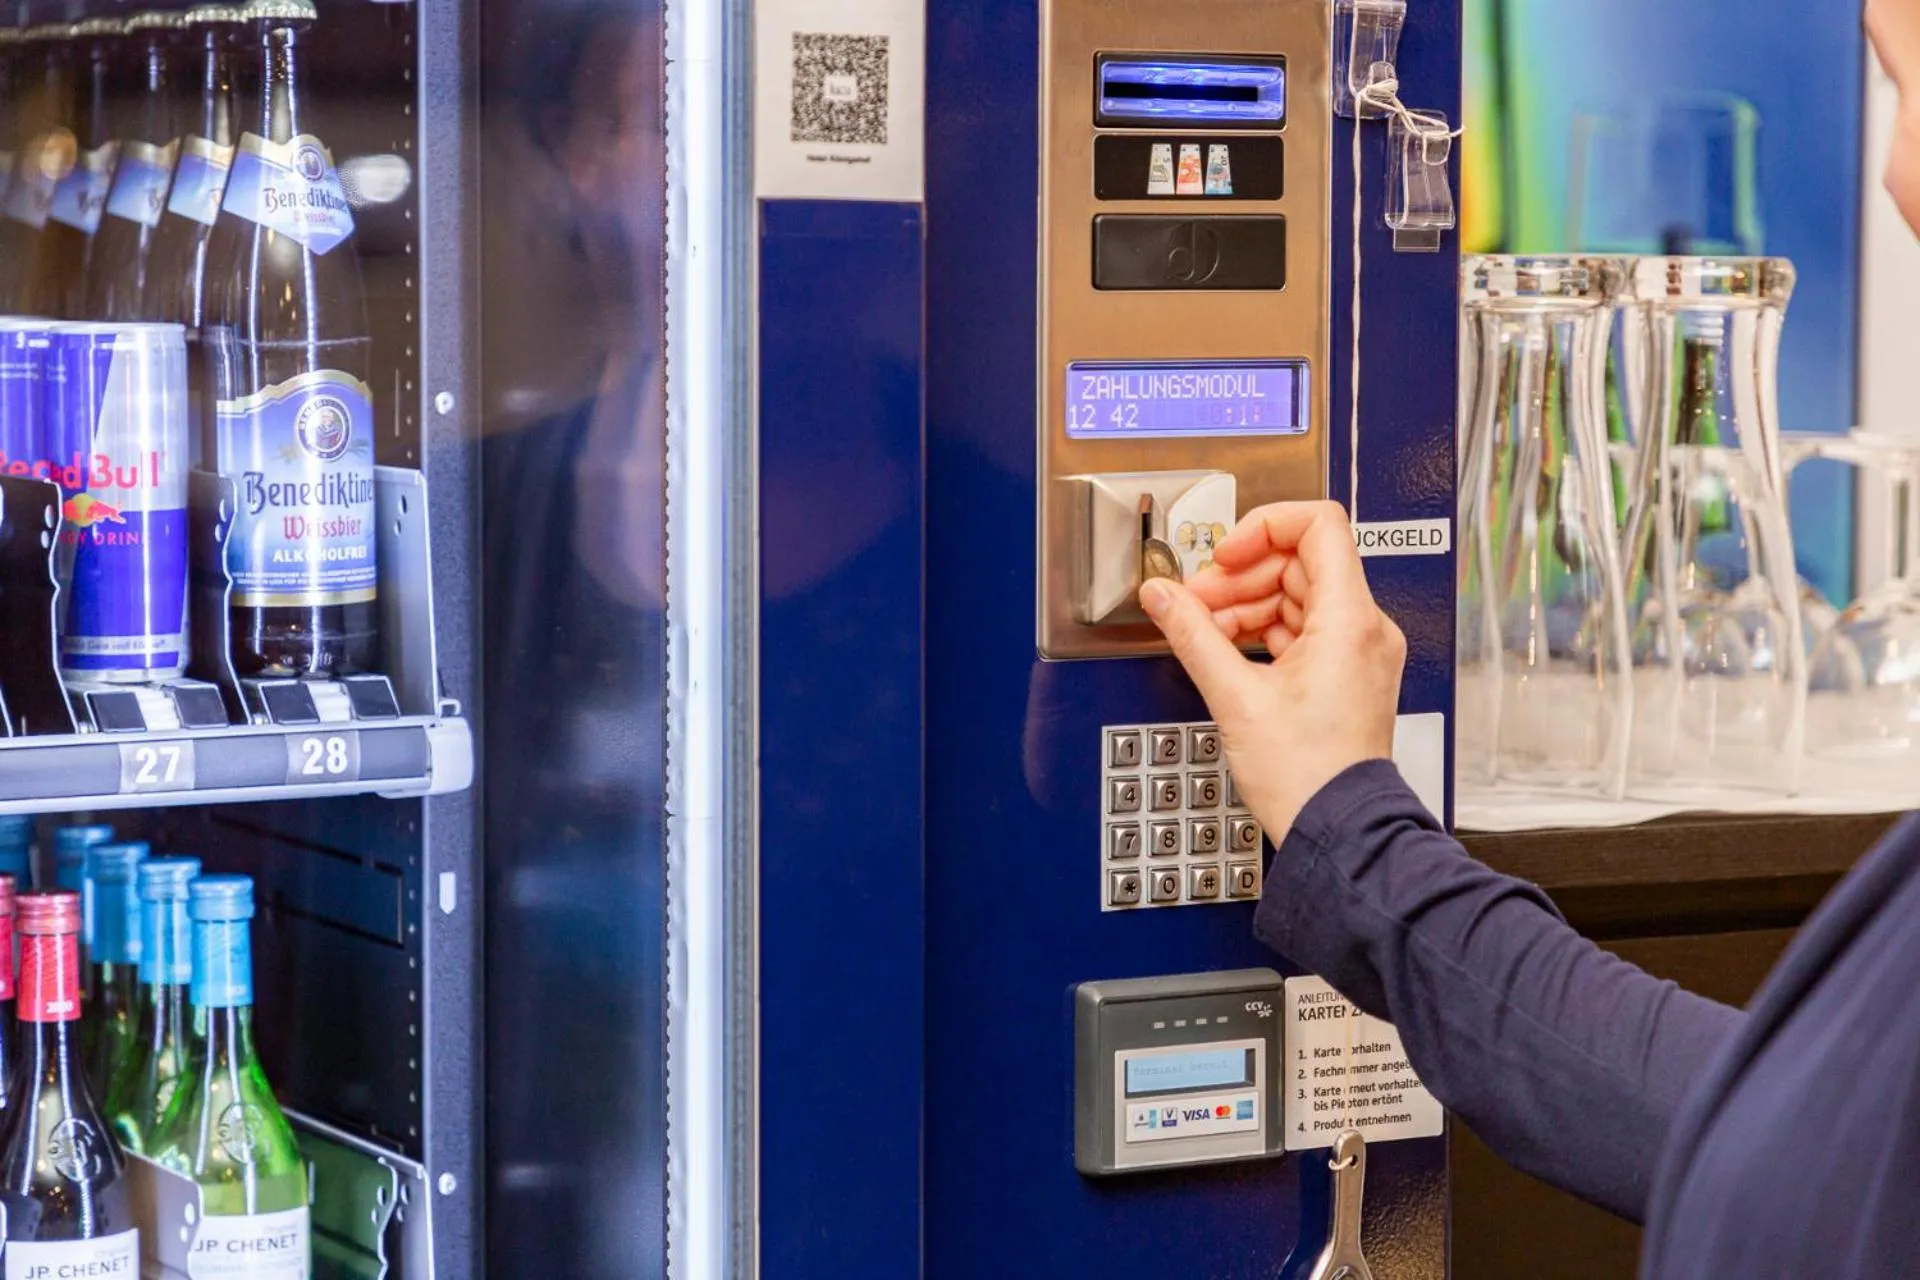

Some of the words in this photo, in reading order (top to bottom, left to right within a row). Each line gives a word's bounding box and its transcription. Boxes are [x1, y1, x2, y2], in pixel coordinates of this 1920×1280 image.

[1069, 404, 1096, 428] 12
[1110, 404, 1139, 428] 42
[243, 471, 373, 515] Benediktine
[302, 736, 348, 774] 28
[1126, 742, 1135, 758] 1
[1164, 739, 1176, 757] 2
[1204, 737, 1216, 755] 3
[135, 746, 181, 783] 27
[1125, 788, 1136, 805] 4
[1164, 785, 1176, 803] 5
[1203, 783, 1216, 801] 6
[1125, 833, 1136, 850] 7
[1163, 830, 1176, 848] 8
[1203, 828, 1216, 845] 9
[1242, 825, 1255, 843] C
[1242, 871, 1255, 889] D
[1313, 1047, 1342, 1058] Karte
[1313, 1064, 1378, 1078] Fachnmmer
[1313, 1086, 1341, 1097] Karte
[1343, 1082, 1376, 1094] rneut
[1313, 1101, 1328, 1111] bis
[1371, 1094, 1403, 1105] ertönt
[1182, 1108, 1210, 1121] VISA
[1313, 1118, 1353, 1131] Produt
[1356, 1112, 1412, 1127] entnehmen
[195, 1240, 218, 1252] JP
[226, 1233, 297, 1253] CHENET
[25, 1266, 49, 1279] JP
[58, 1256, 129, 1278] CHENET
